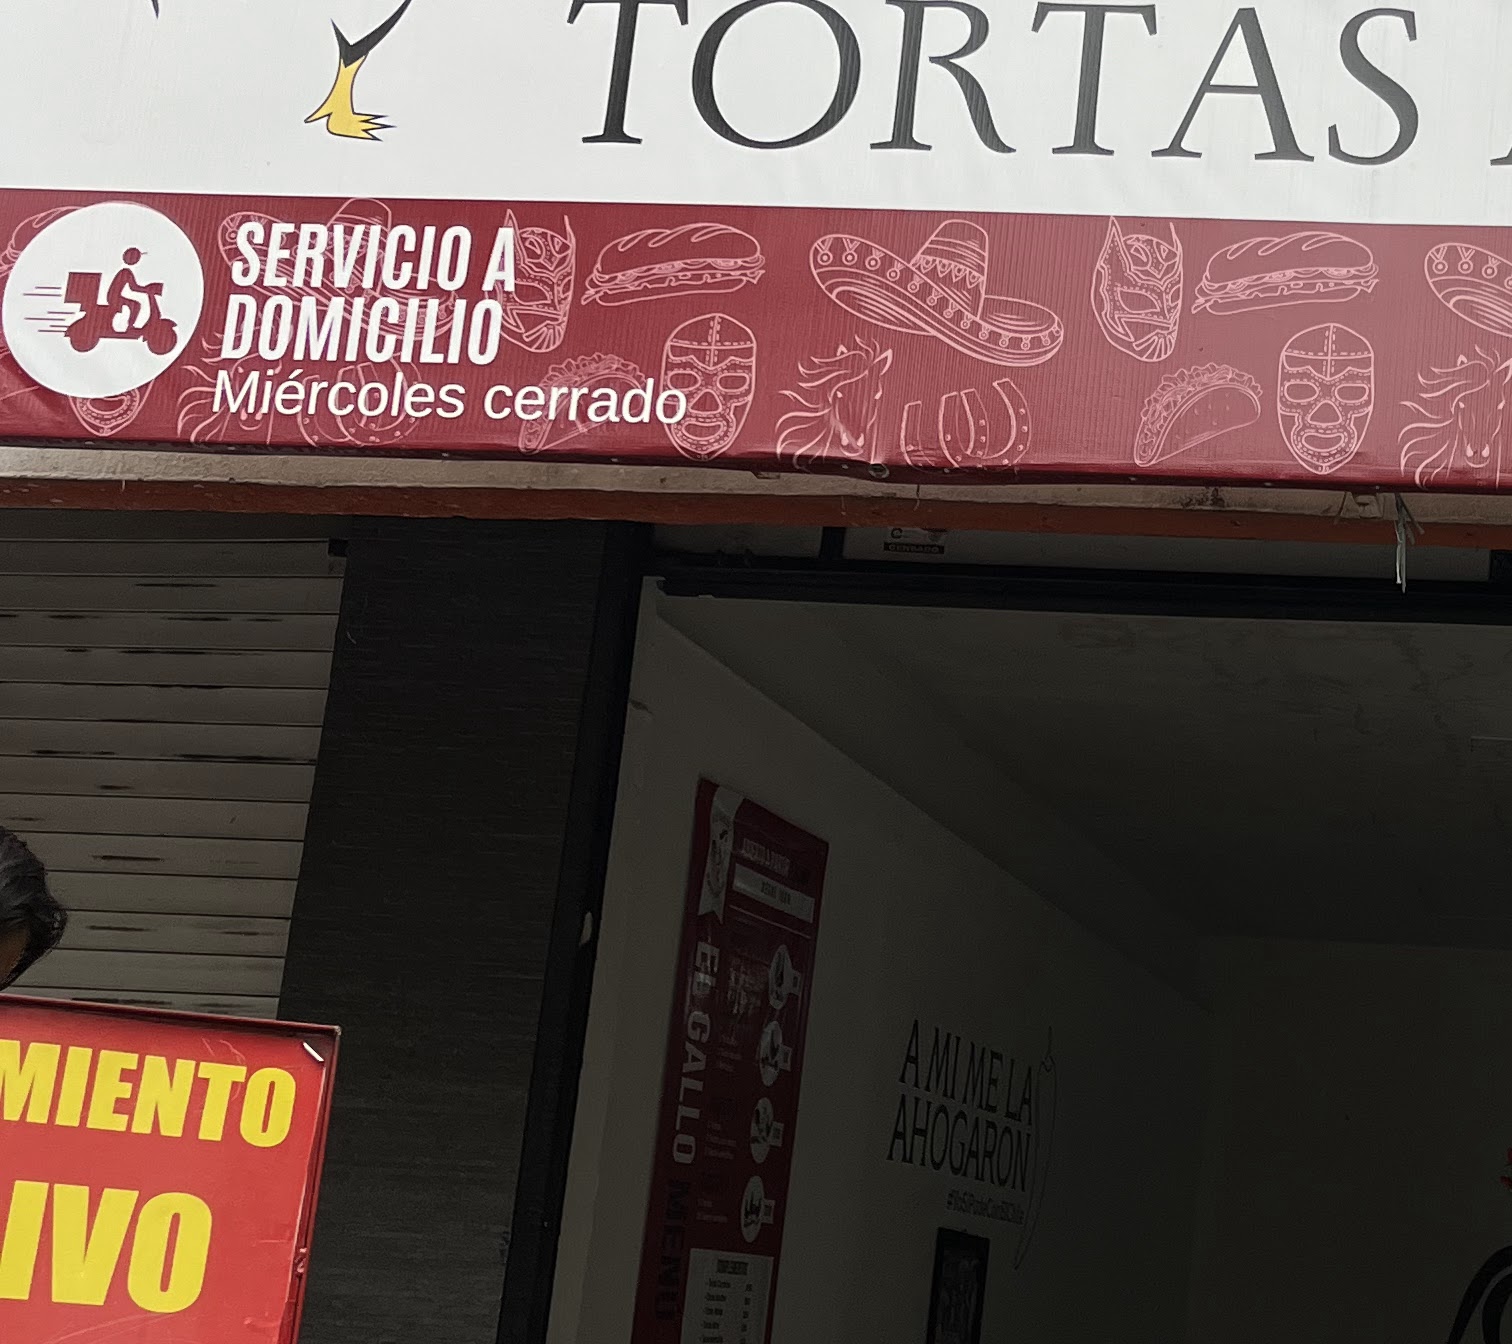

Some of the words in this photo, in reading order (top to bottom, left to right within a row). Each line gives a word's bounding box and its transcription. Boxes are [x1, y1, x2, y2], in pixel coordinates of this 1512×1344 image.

[231, 221, 472, 292] SERVICIO
[481, 227, 515, 292] A
[220, 294, 503, 365] DOMICILIO
[212, 367, 466, 421] Miércoles
[483, 377, 688, 425] cerrado
[0, 1038, 297, 1148] MIENTO
[672, 1011, 712, 1165] GALLO
[899, 1019, 920, 1089] A
[923, 1027, 961, 1100] MI
[961, 1040, 1003, 1114] ME
[1004, 1058, 1033, 1126] LA
[886, 1093, 1032, 1192] AHOGARON
